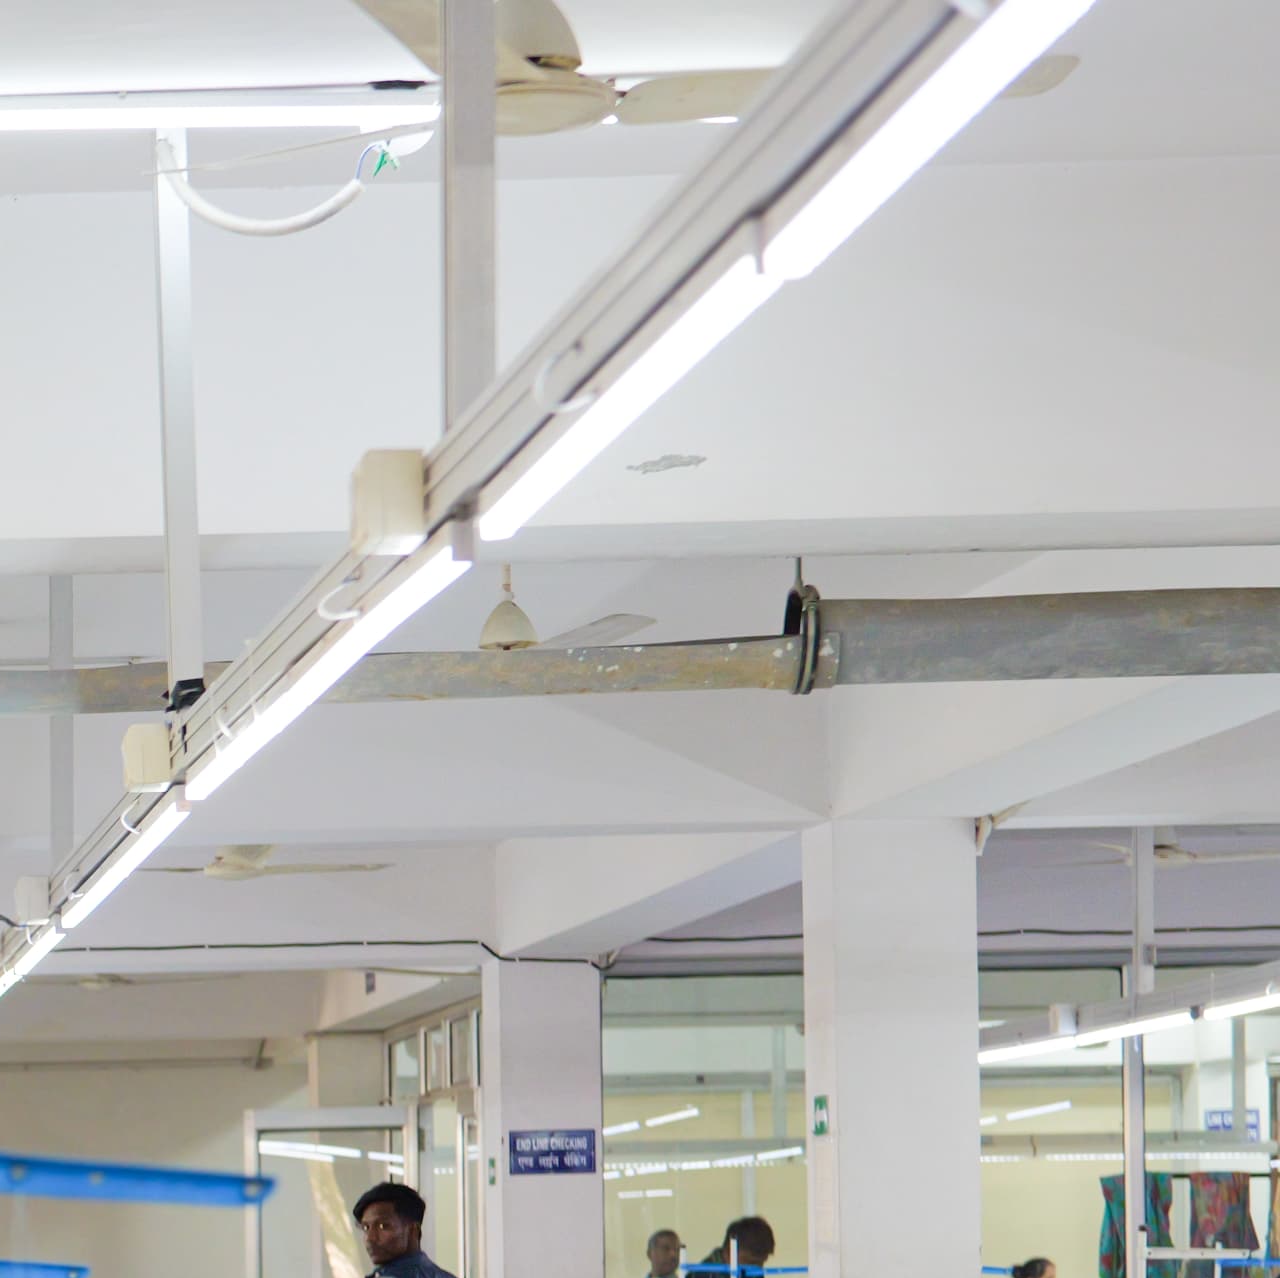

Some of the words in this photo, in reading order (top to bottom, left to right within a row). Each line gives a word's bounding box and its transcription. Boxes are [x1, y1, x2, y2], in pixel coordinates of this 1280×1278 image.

[516, 1138, 531, 1151] END
[532, 1137, 548, 1151] LINE
[550, 1136, 587, 1150] CHECKING
